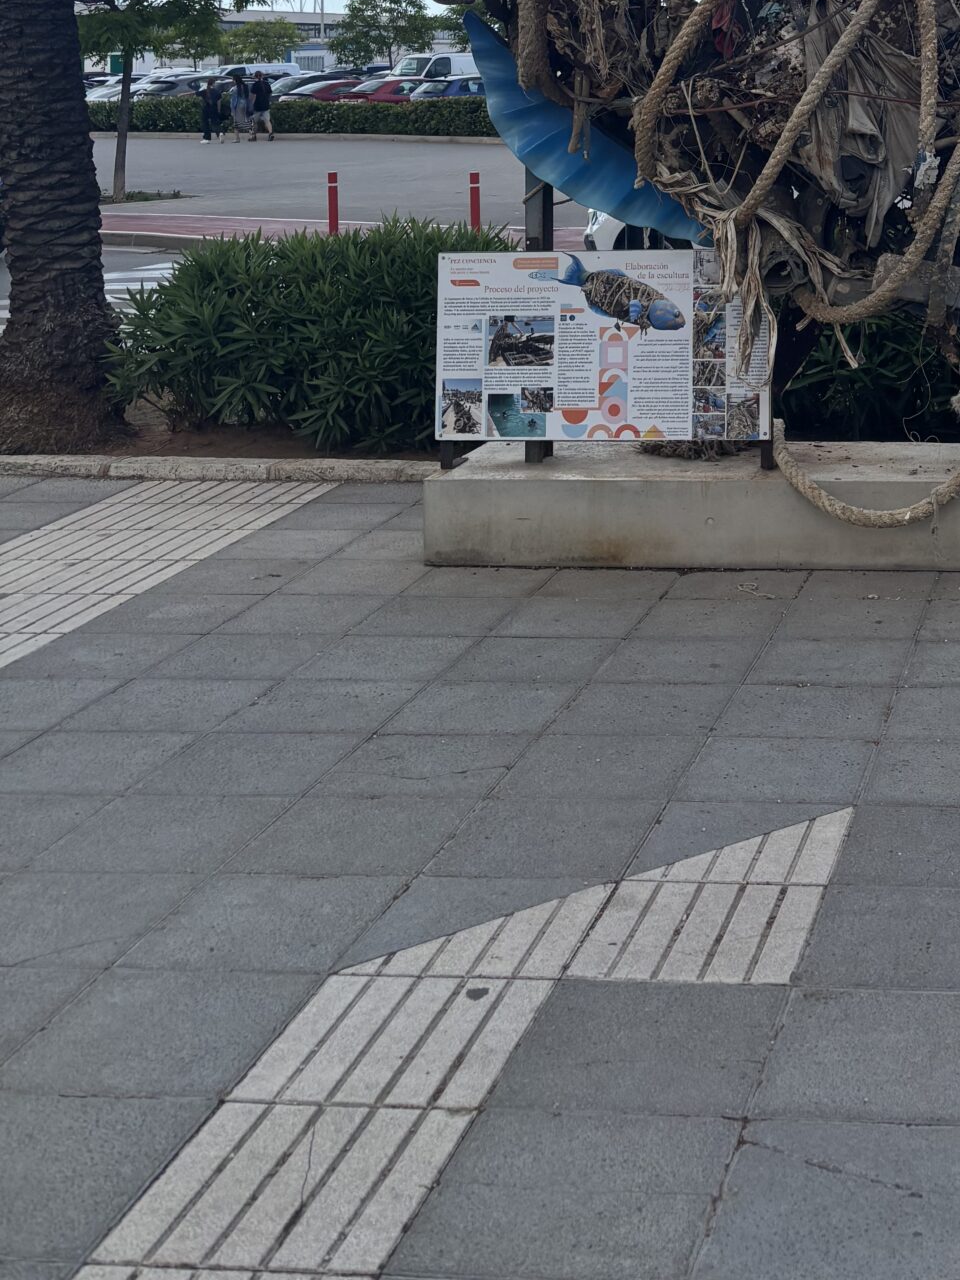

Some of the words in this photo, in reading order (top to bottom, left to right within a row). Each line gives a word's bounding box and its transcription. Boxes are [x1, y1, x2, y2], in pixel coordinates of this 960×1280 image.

[625, 262, 669, 270] Elaboración
[484, 285, 513, 293] Proceso
[514, 285, 526, 293] del
[527, 286, 559, 295] proyecto
